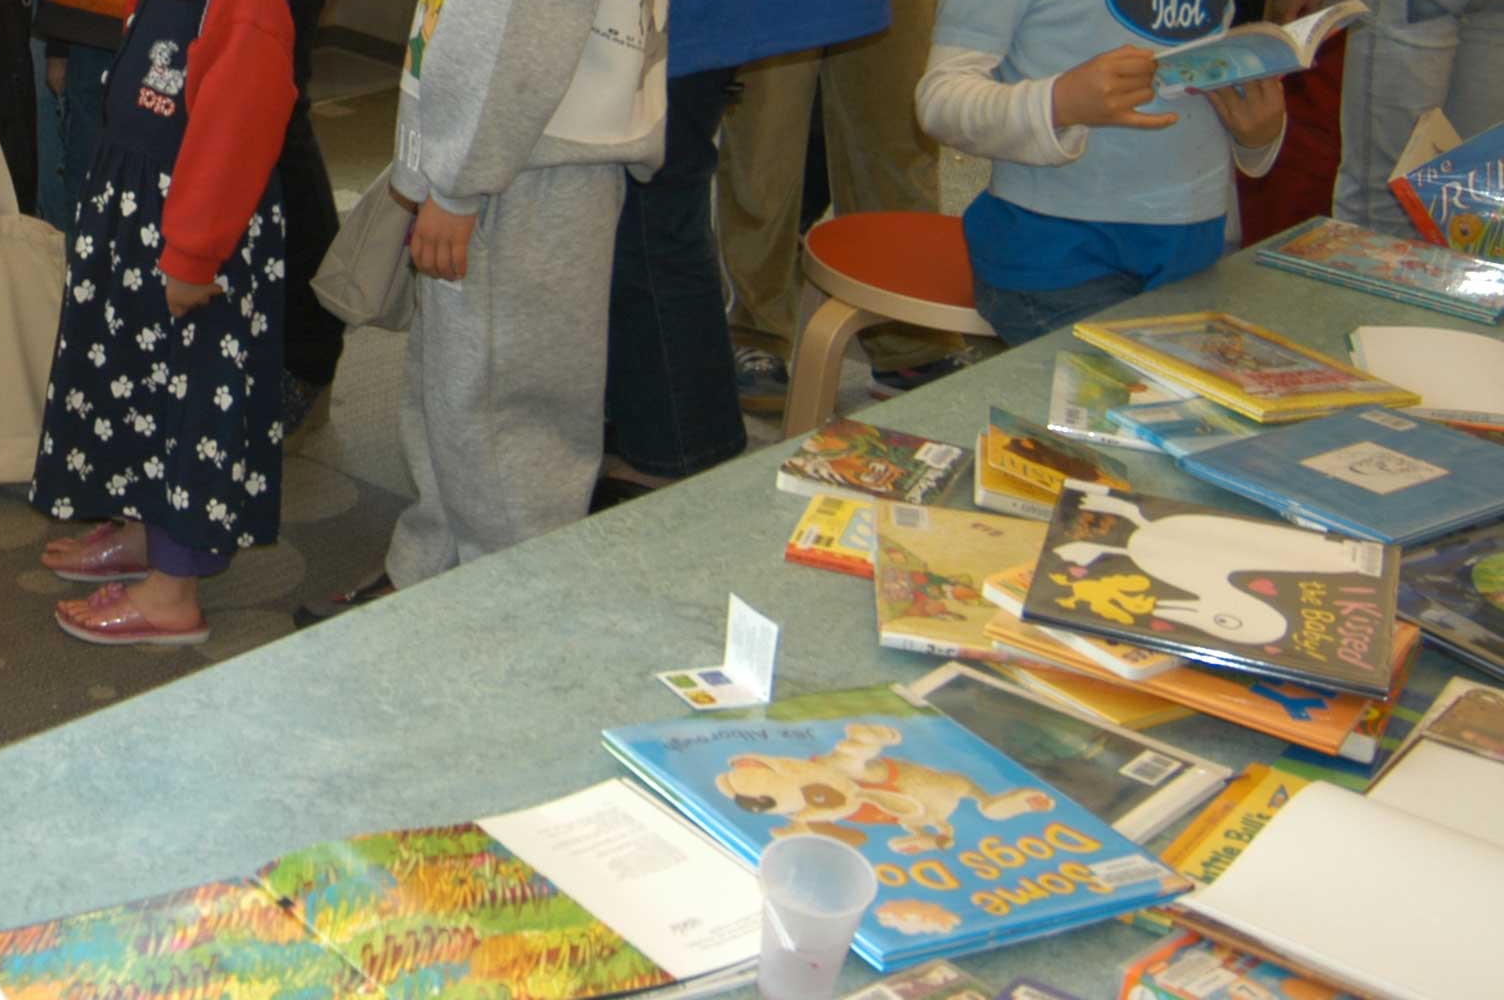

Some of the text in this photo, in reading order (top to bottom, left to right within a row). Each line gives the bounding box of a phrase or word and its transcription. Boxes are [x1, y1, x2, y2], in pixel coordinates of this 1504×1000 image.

[1292, 581, 1335, 662] the Baby!
[1333, 600, 1383, 671] Kissed
[873, 821, 1103, 891] Dogs Do
[971, 860, 1115, 917] Some
